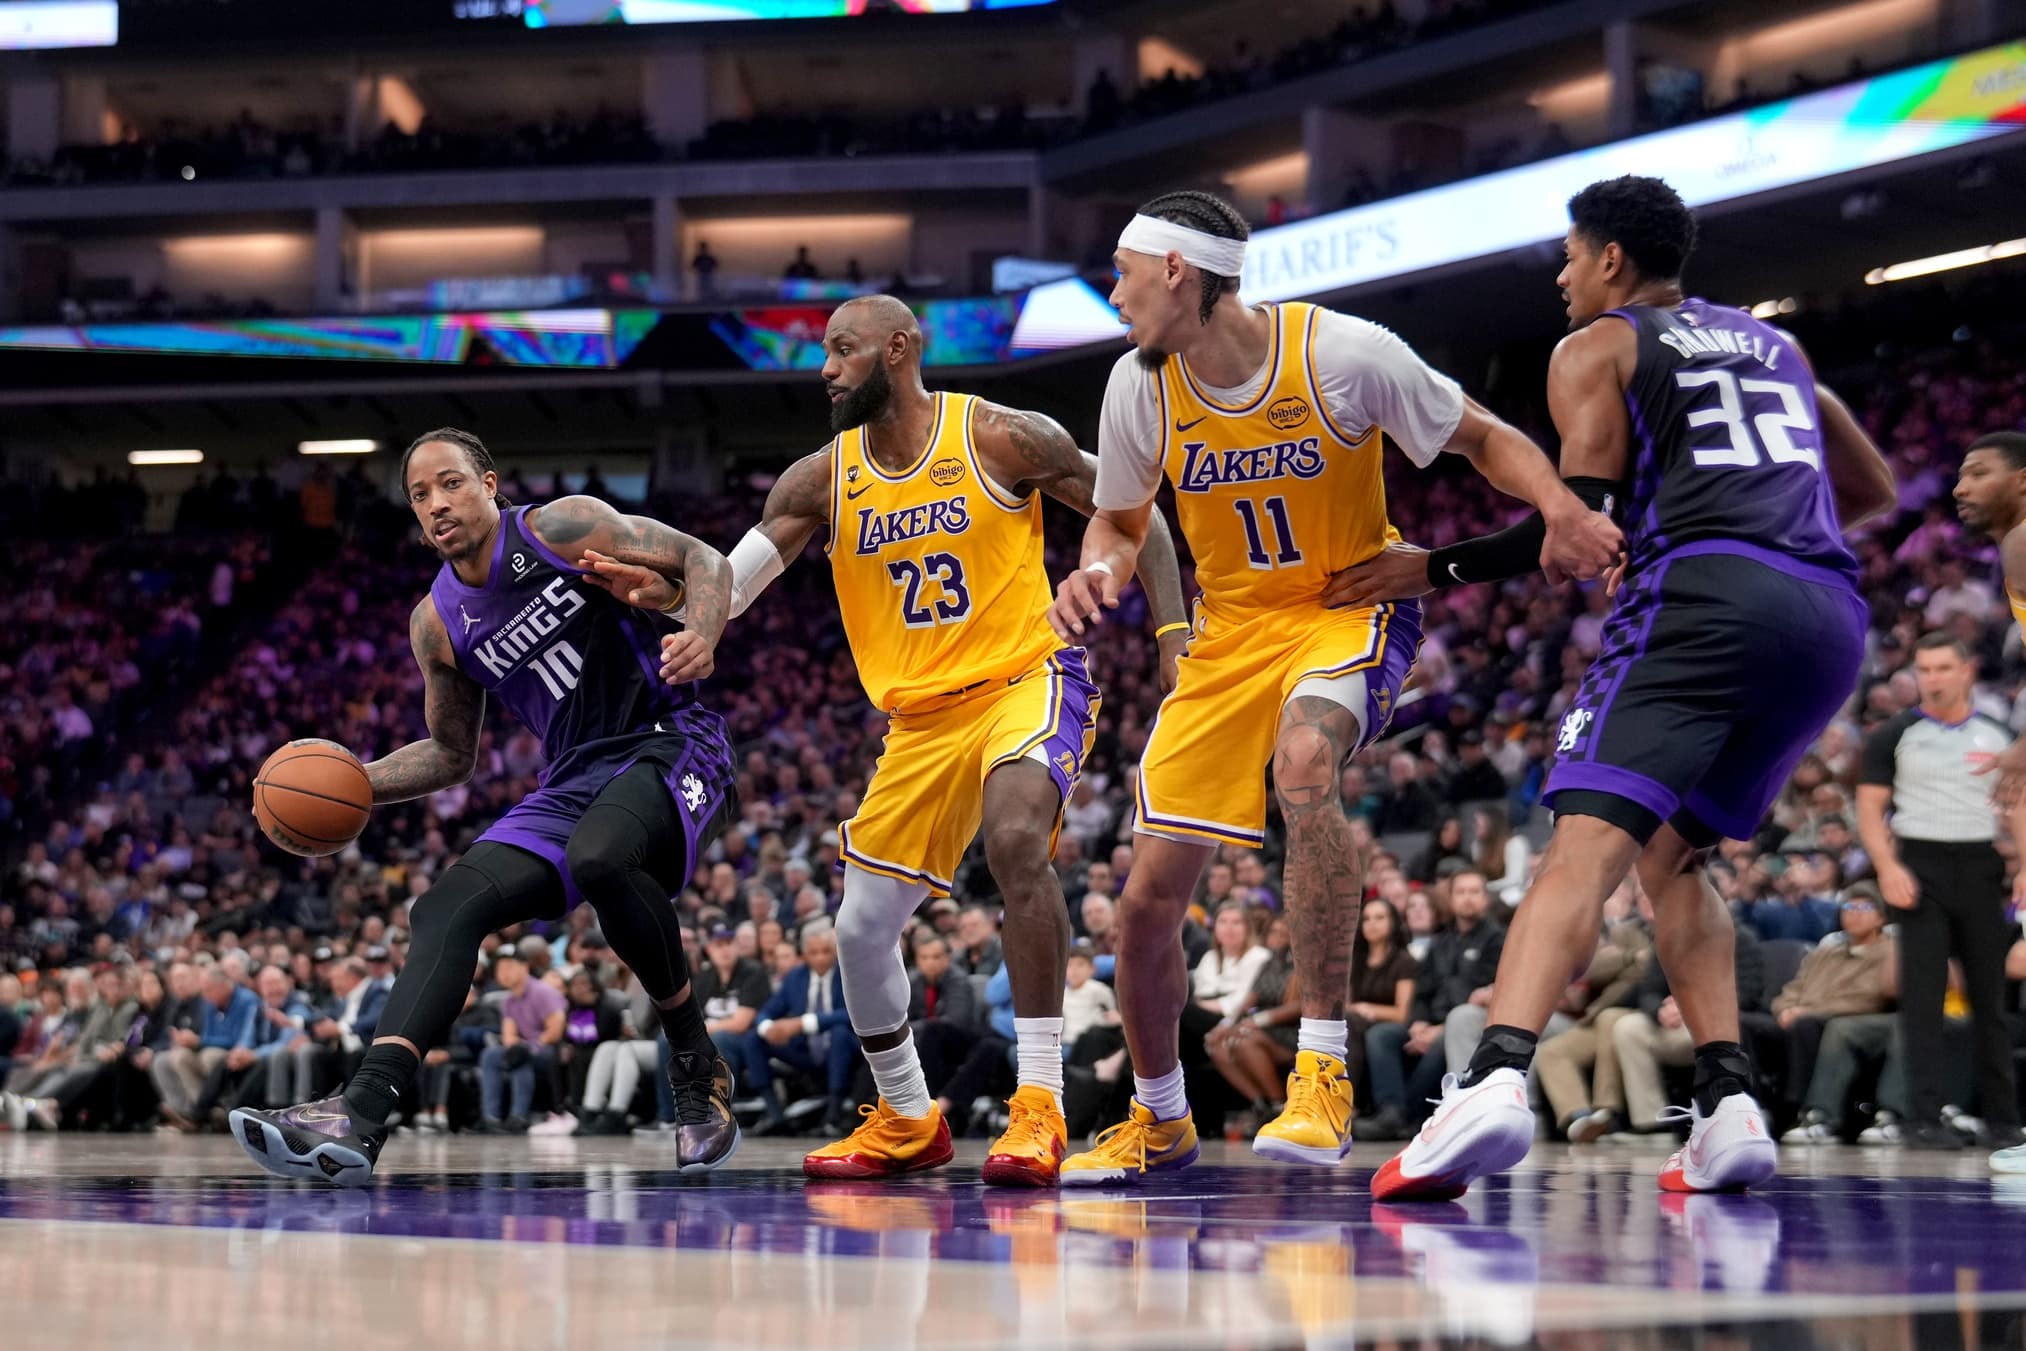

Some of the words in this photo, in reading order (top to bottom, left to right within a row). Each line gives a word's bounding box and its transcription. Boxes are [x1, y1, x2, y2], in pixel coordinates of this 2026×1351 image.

[1242, 220, 1398, 291] HARIF'S
[1270, 403, 1307, 419] bibigo
[1674, 369, 1819, 472] 32
[932, 462, 963, 478] bibigo
[1176, 435, 1327, 494] LAKERS
[855, 495, 972, 557] LAKERS
[1232, 495, 1305, 571] 11
[491, 596, 541, 642] SACRAMENTO
[885, 551, 973, 630] 23
[473, 576, 587, 679] KINGS
[526, 639, 584, 701] 10
